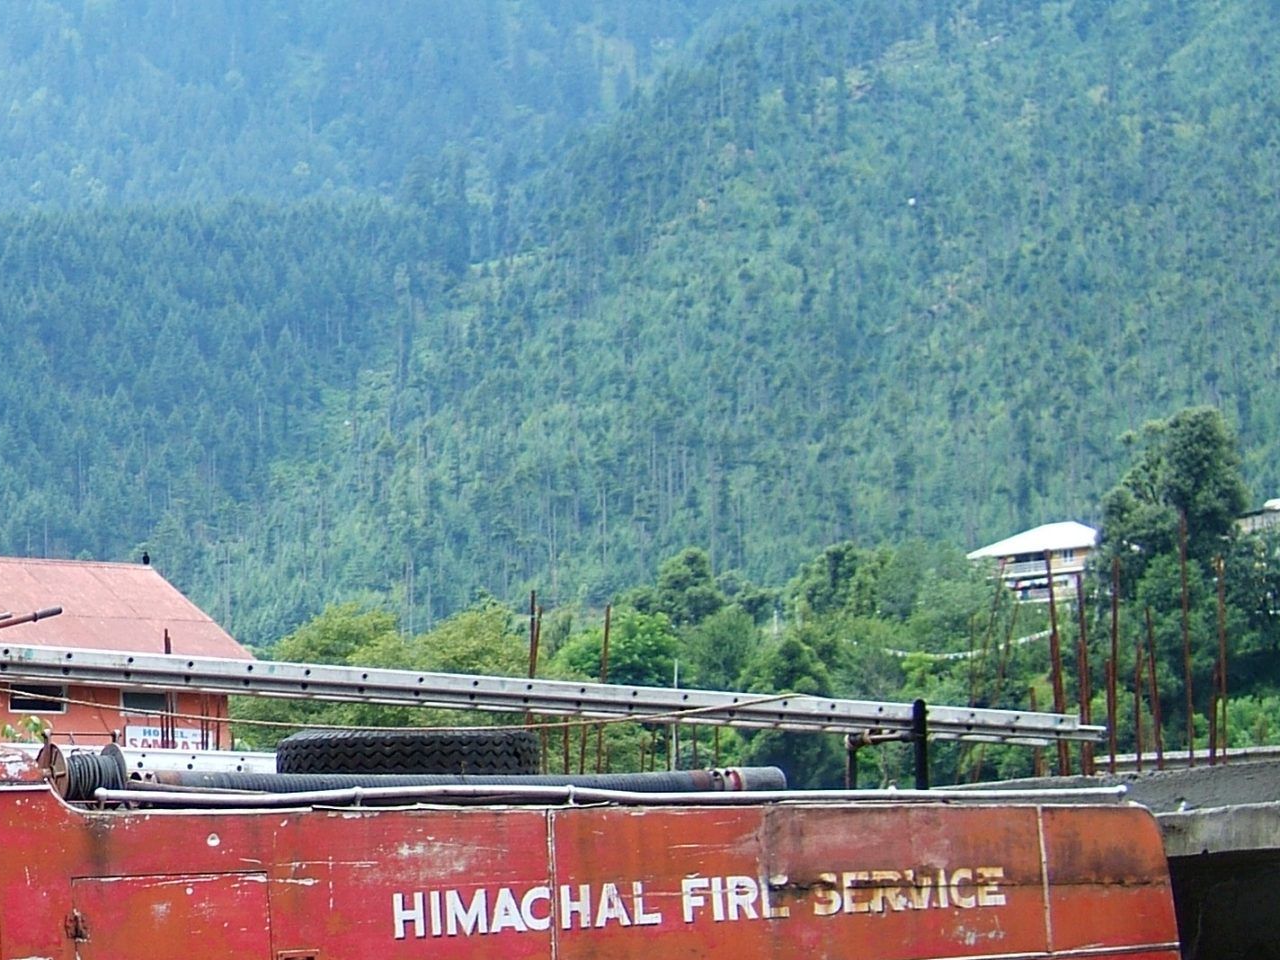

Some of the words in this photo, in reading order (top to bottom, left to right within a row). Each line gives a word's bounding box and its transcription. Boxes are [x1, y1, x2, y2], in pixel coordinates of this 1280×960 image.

[393, 881, 662, 939] HIMACHAL
[681, 874, 790, 922] FIRE
[813, 866, 1006, 917] SERVICE
